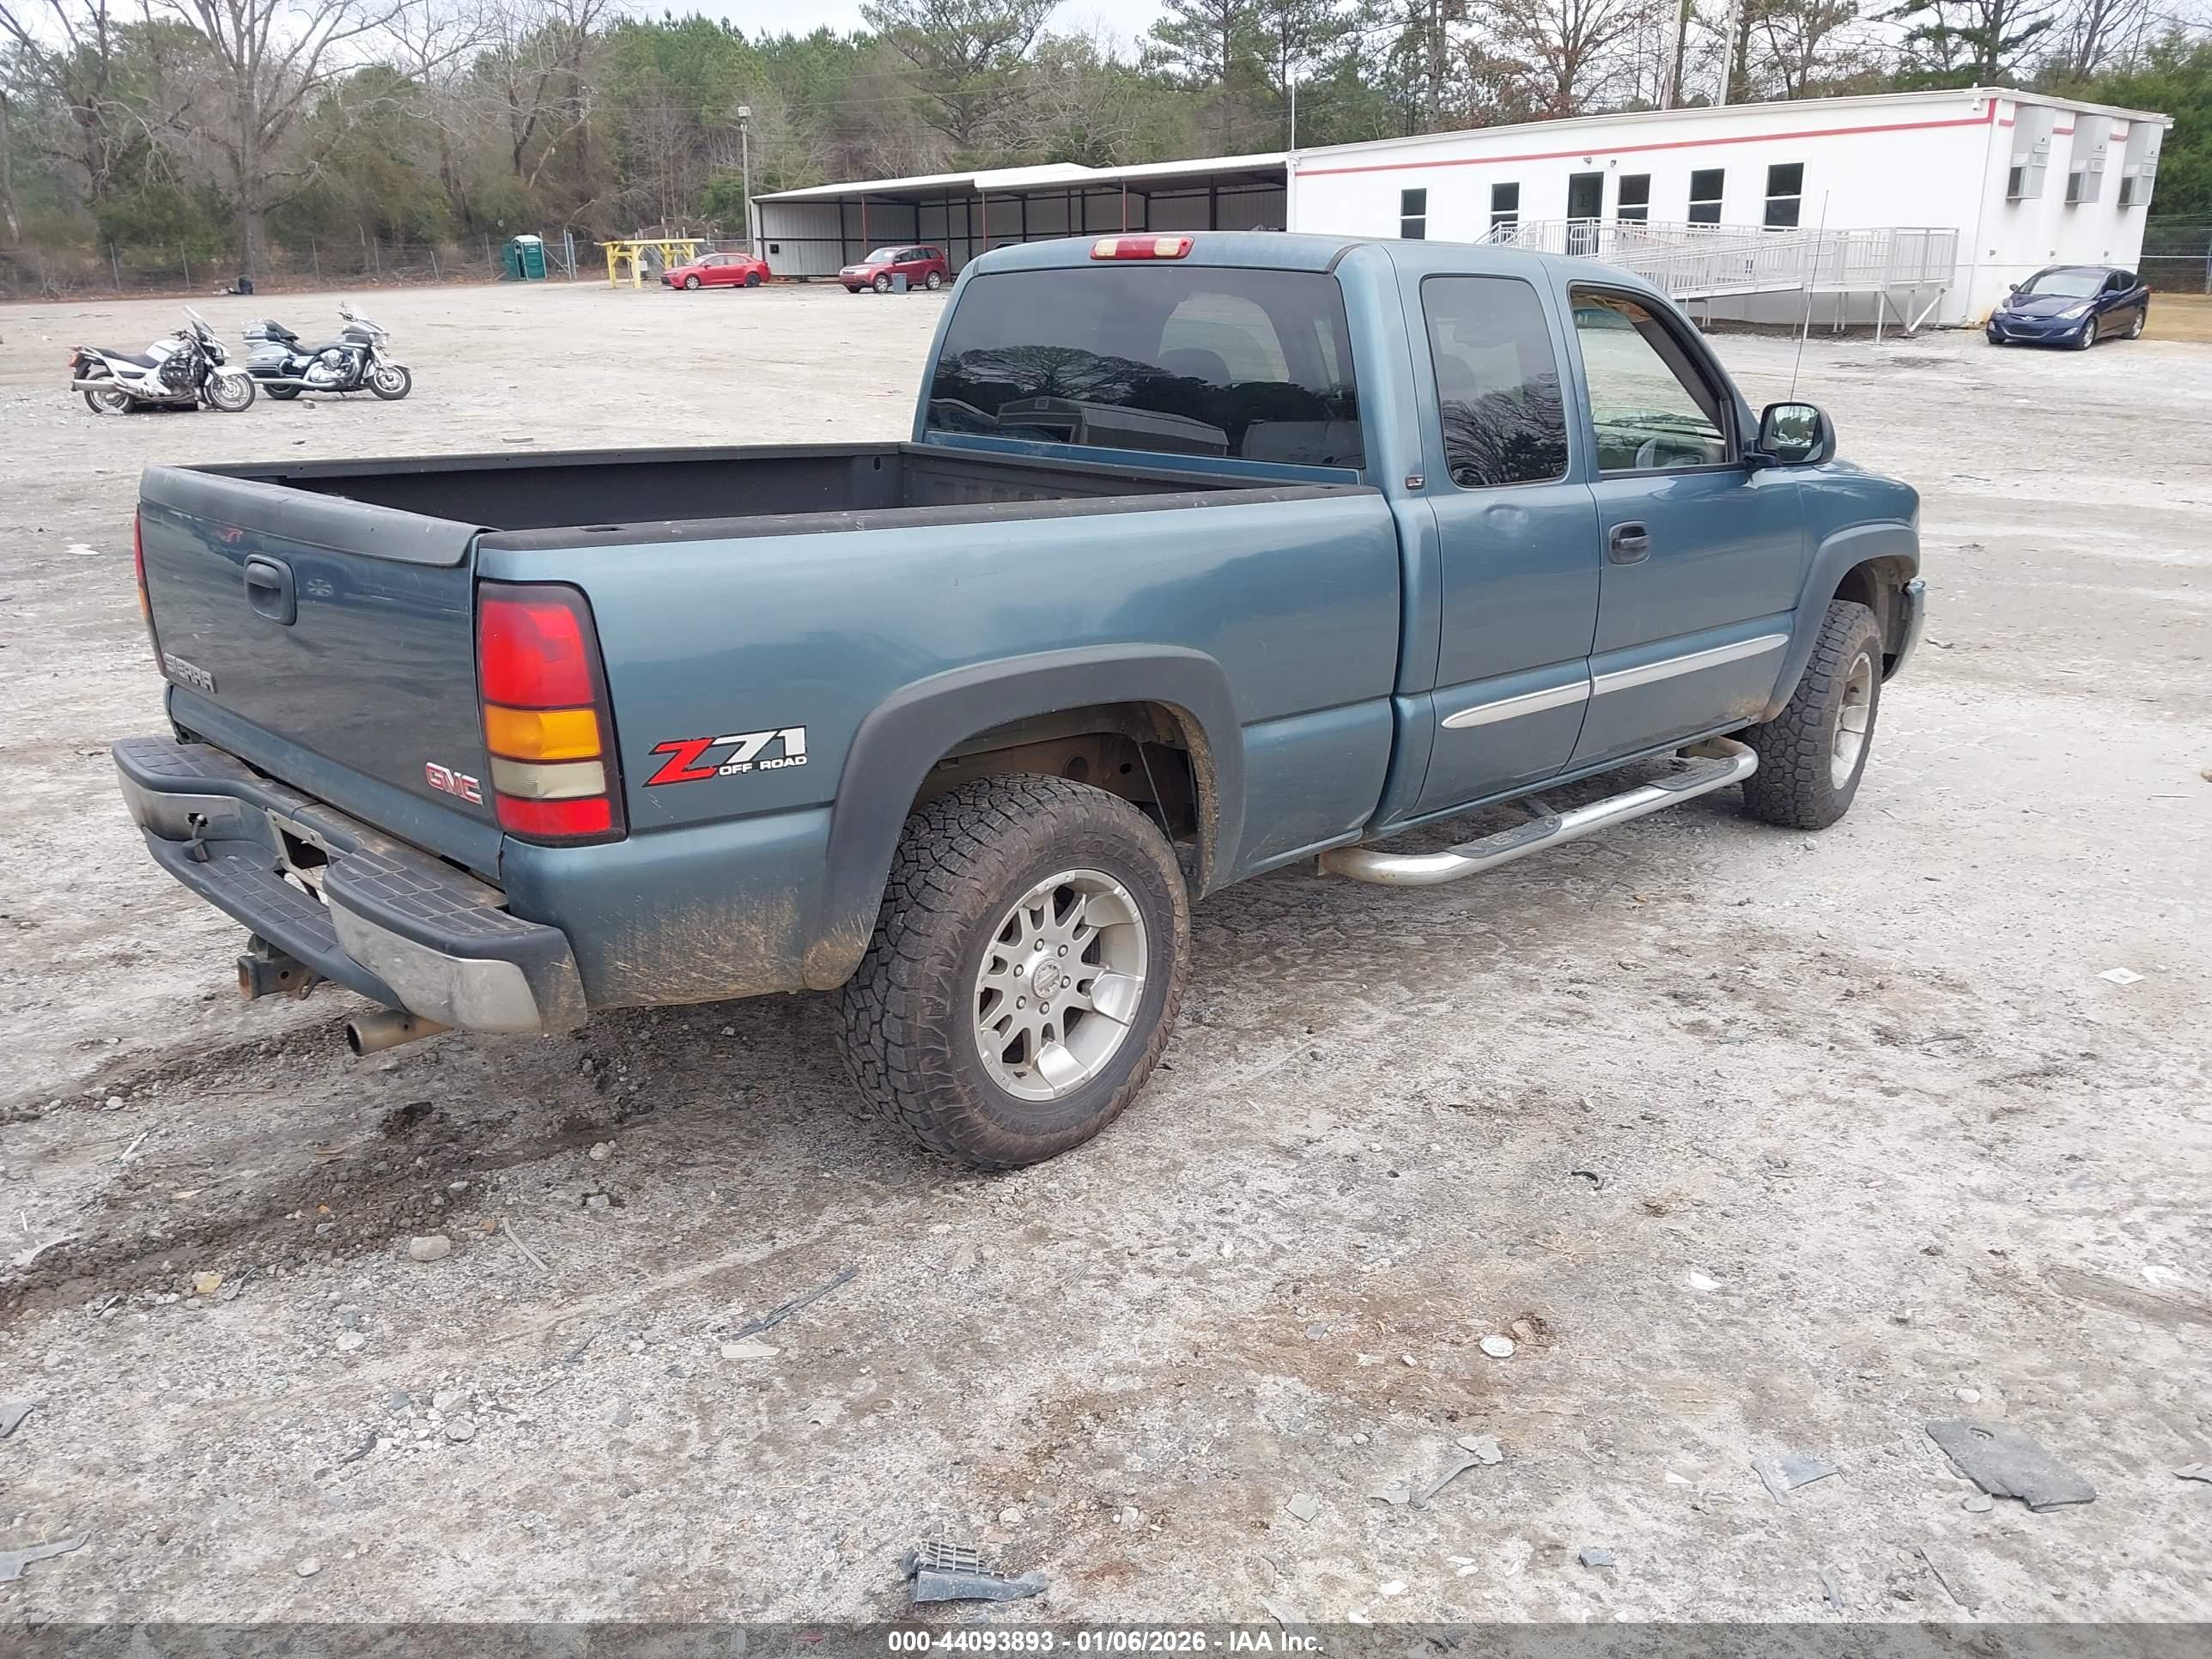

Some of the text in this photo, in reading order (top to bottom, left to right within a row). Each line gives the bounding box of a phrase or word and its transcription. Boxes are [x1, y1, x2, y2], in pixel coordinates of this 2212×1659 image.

[165, 653, 215, 693] SIERRA
[642, 726, 807, 787] Z71
[719, 755, 808, 777] OFF ROAD
[426, 762, 483, 805] GMC
